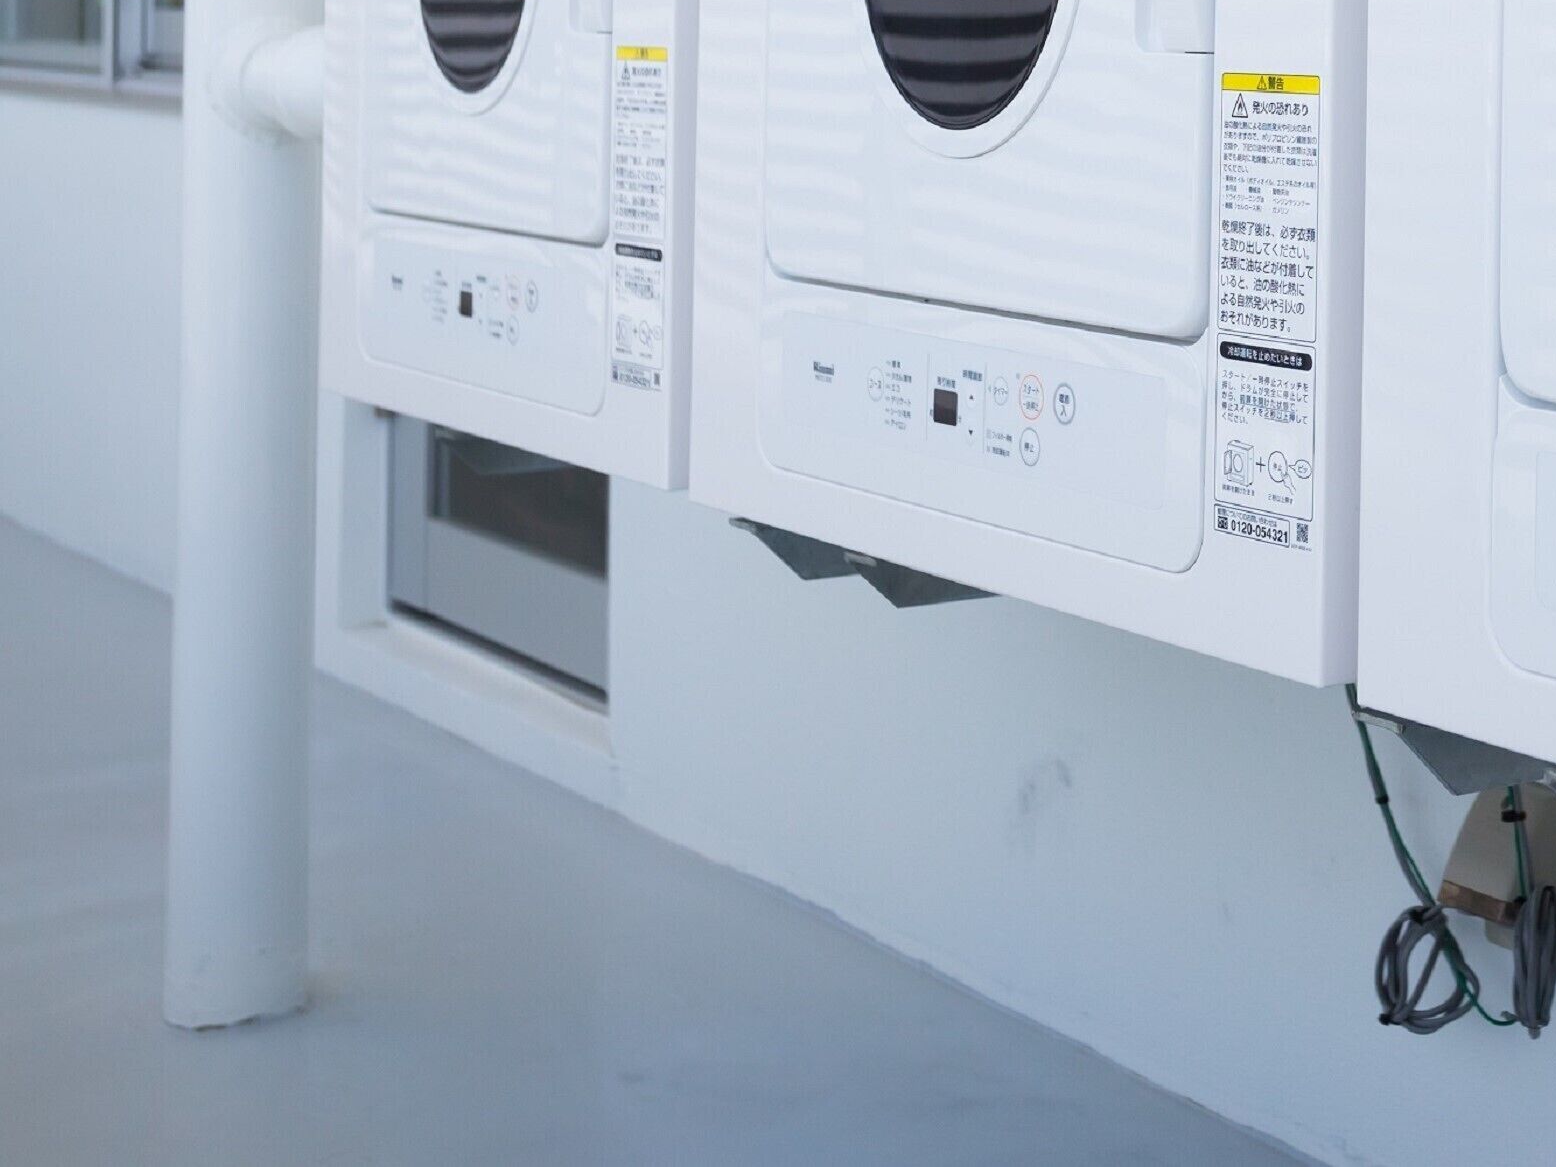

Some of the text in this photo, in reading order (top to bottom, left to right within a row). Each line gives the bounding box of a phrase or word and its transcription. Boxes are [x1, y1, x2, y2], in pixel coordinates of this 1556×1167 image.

[1267, 76, 1284, 90] 警告
[1252, 99, 1309, 118] 発火の恐れあり
[1221, 217, 1315, 244] 乾燥終了後は、必ず衣類
[1221, 235, 1310, 262] を取り出してください。
[1220, 253, 1313, 281] 衣類に油などが付着して
[1220, 271, 1305, 298] いると、油の酸化熱に
[1220, 290, 1304, 317] よる自然発火や引火の
[1219, 308, 1291, 333] おそれがあります。
[1227, 346, 1302, 366] 冷却運転を止めたいときは
[1230, 518, 1288, 543] 0120-054321
